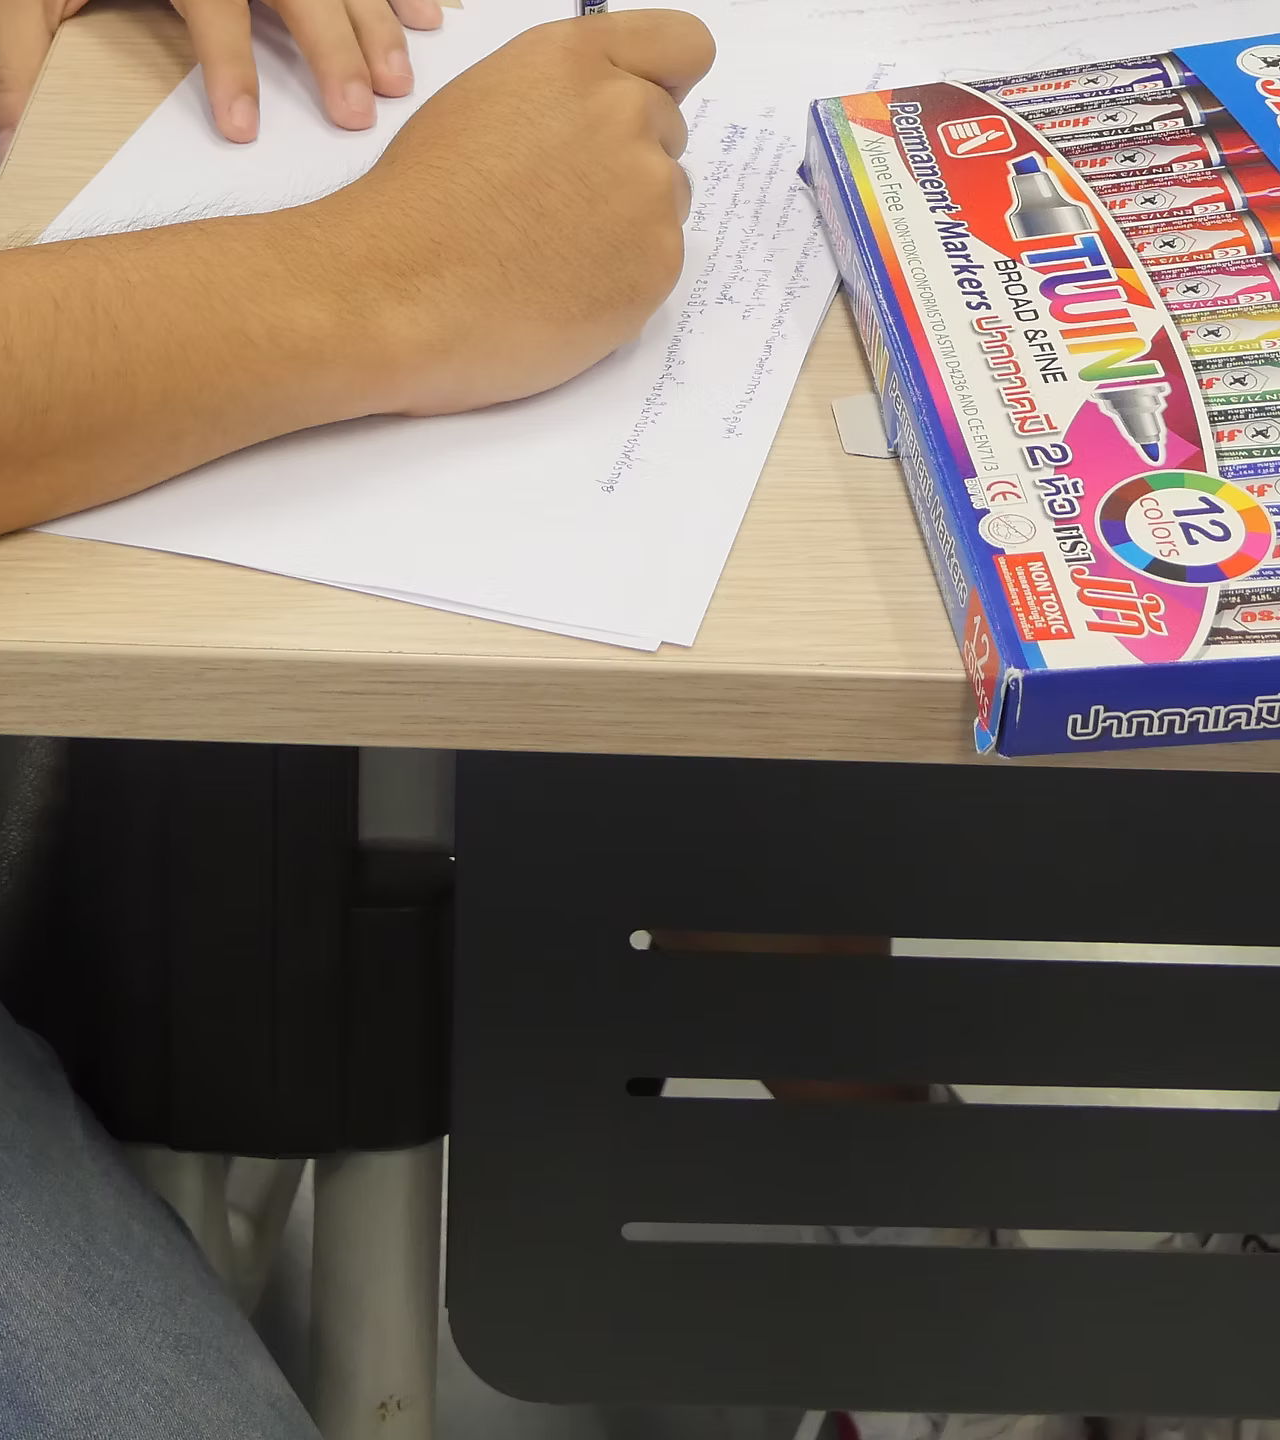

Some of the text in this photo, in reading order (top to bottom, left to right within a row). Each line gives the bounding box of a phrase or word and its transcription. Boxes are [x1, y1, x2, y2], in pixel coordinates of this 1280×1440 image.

[1000, 78, 1078, 98] Horse
[1032, 115, 1098, 133] Hors
[861, 137, 904, 212] Xylene Free
[887, 101, 992, 311] Permanent Markers
[994, 259, 1040, 322] BROAD
[1022, 233, 1164, 383] TWIN
[892, 216, 999, 472] NON-TOXIC CONFORMS TO ASTM D4236 AND CE-EN71/3
[889, 371, 934, 505] Permanent
[929, 496, 968, 609] Markers
[974, 315, 1168, 637] ปากกาเคมี 2 หัว ตรา ม้า
[1140, 497, 1179, 558] colors
[1173, 496, 1232, 546] 12
[1027, 561, 1068, 635] NON TOXIC
[963, 639, 989, 719] colors
[972, 614, 993, 678] 12
